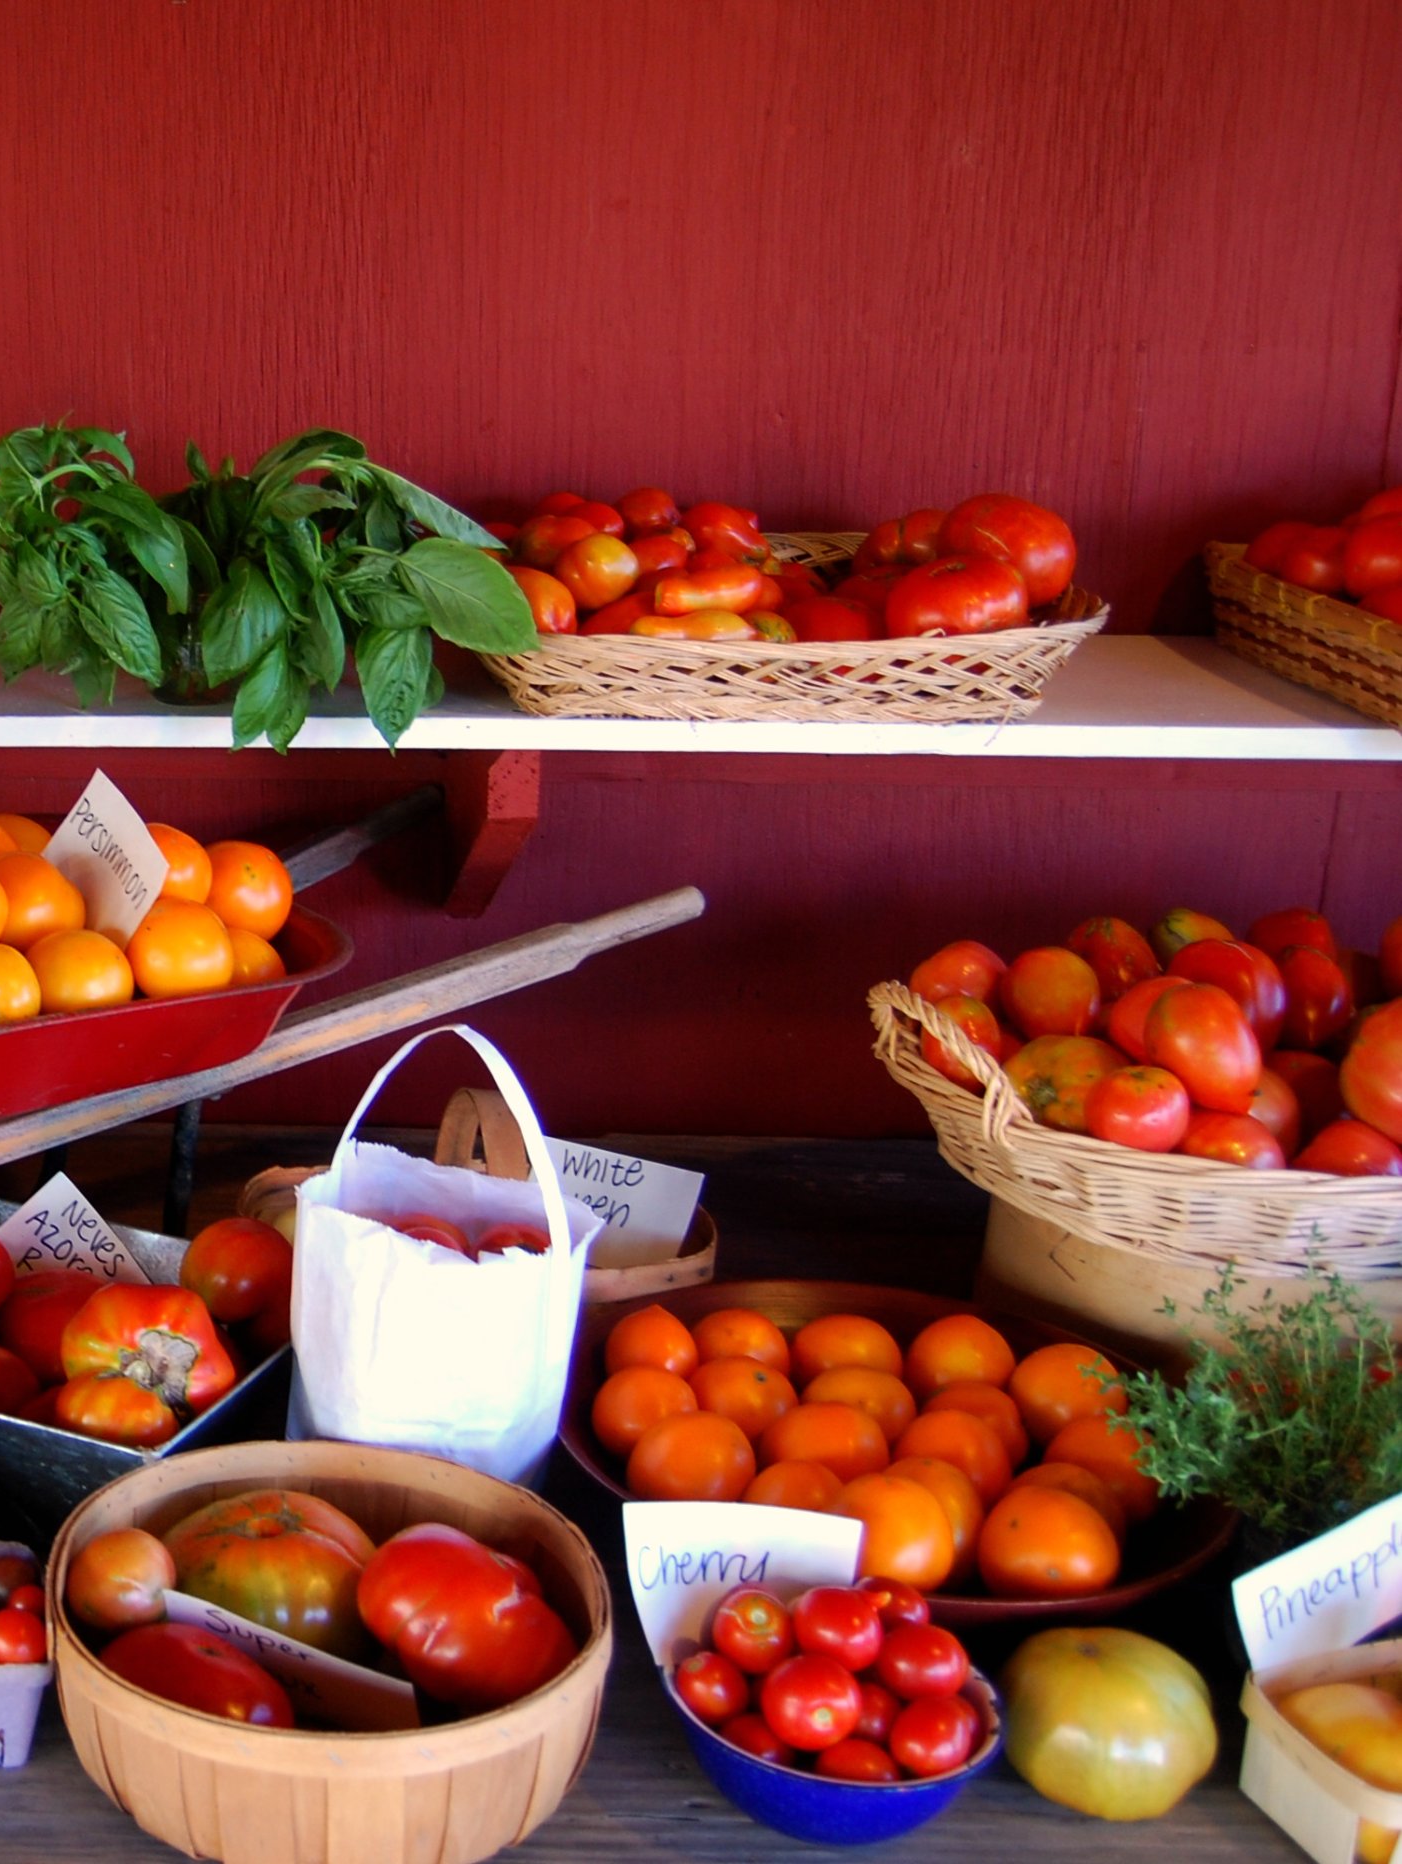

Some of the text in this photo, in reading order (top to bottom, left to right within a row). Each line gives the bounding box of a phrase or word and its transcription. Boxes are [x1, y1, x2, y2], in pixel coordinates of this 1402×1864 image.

[562, 1148, 645, 1187] White
[61, 1200, 125, 1277] Neves
[1259, 1521, 1402, 1640] Pineappl
[204, 1609, 316, 1661] Super
